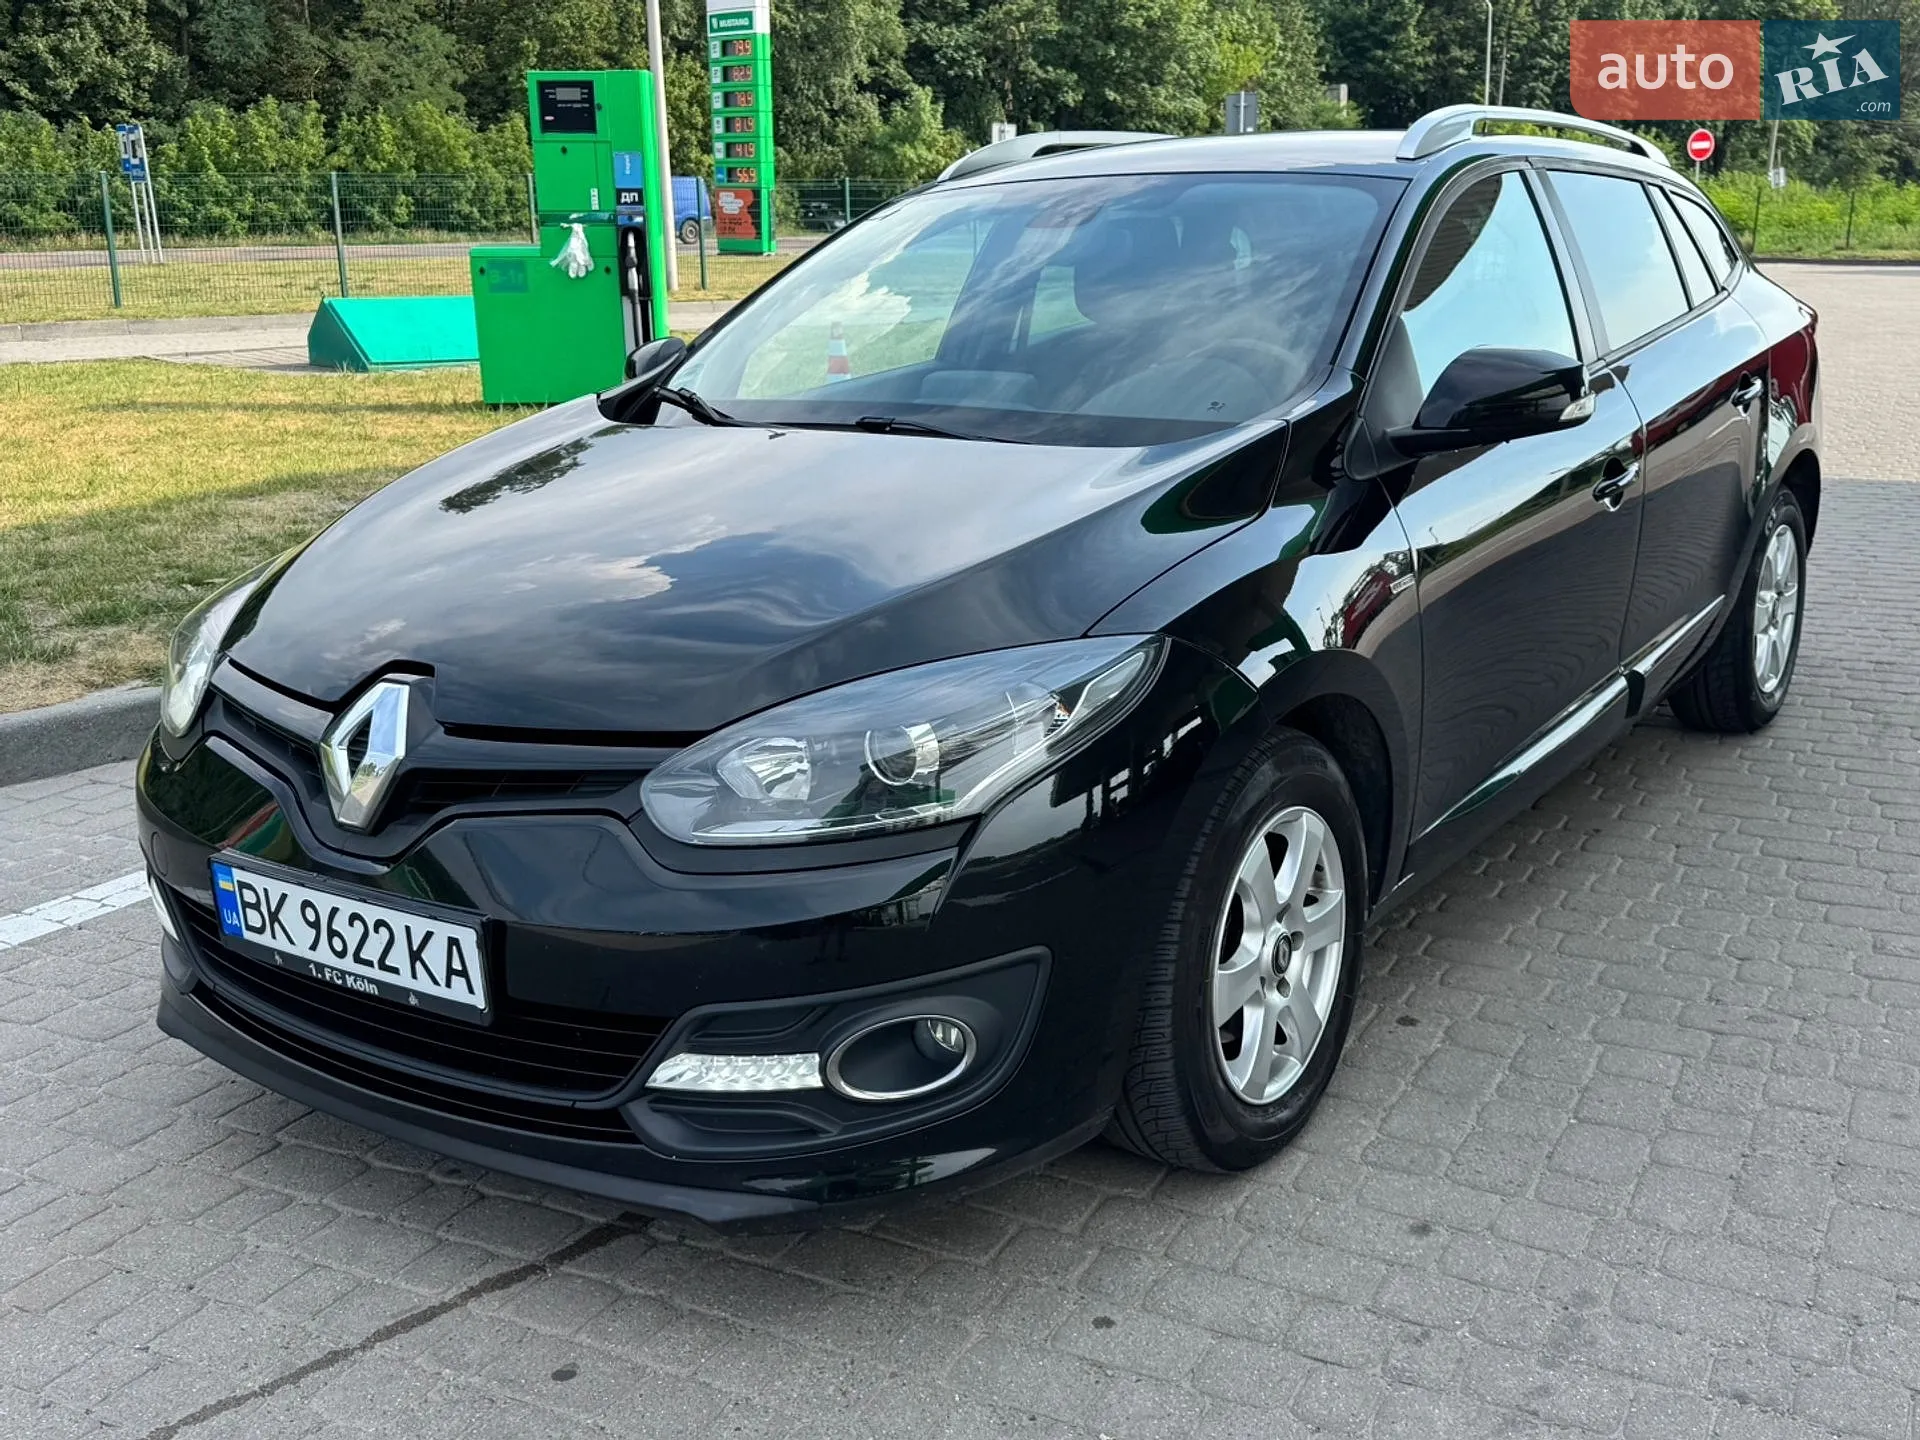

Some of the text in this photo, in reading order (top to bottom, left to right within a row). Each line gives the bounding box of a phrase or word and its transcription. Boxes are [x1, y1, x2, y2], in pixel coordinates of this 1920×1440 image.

[620, 191, 639, 204] ДП
[225, 908, 240, 928] UA
[236, 879, 476, 996] BK 9622 KA
[308, 962, 380, 996] 1. FC Köln
